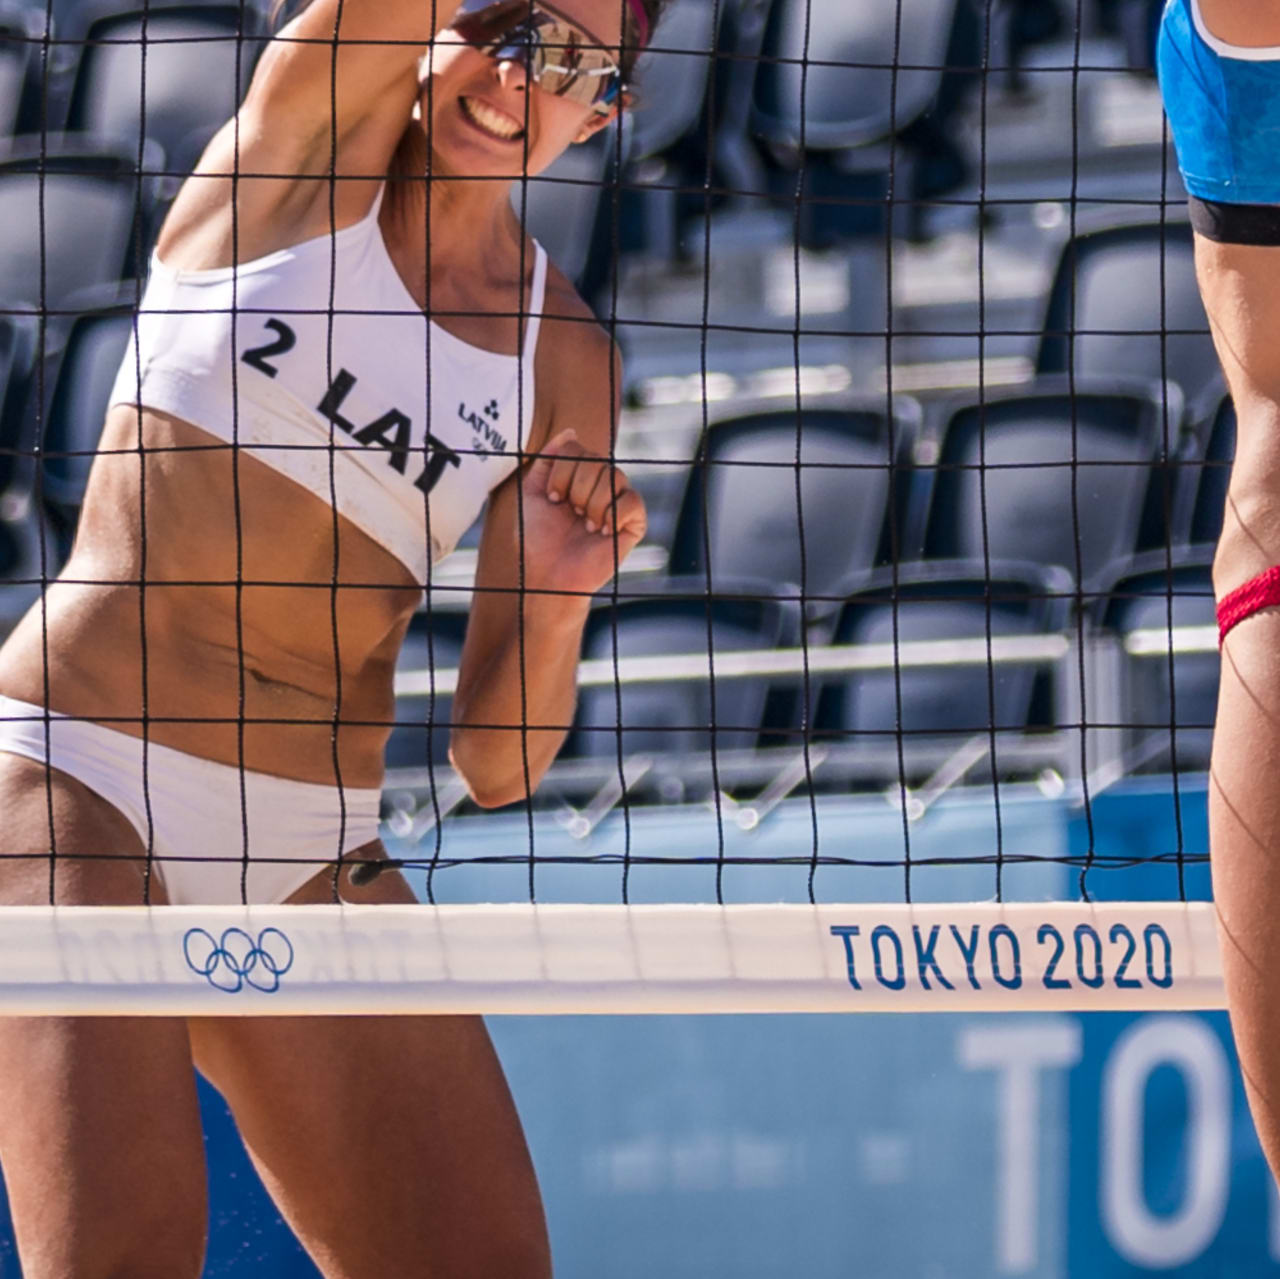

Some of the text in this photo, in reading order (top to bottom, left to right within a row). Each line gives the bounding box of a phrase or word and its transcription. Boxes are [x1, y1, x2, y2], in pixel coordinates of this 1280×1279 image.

[241, 318, 297, 379] 2
[316, 367, 461, 494] LAT
[830, 923, 1173, 991] TOKYO 2020
